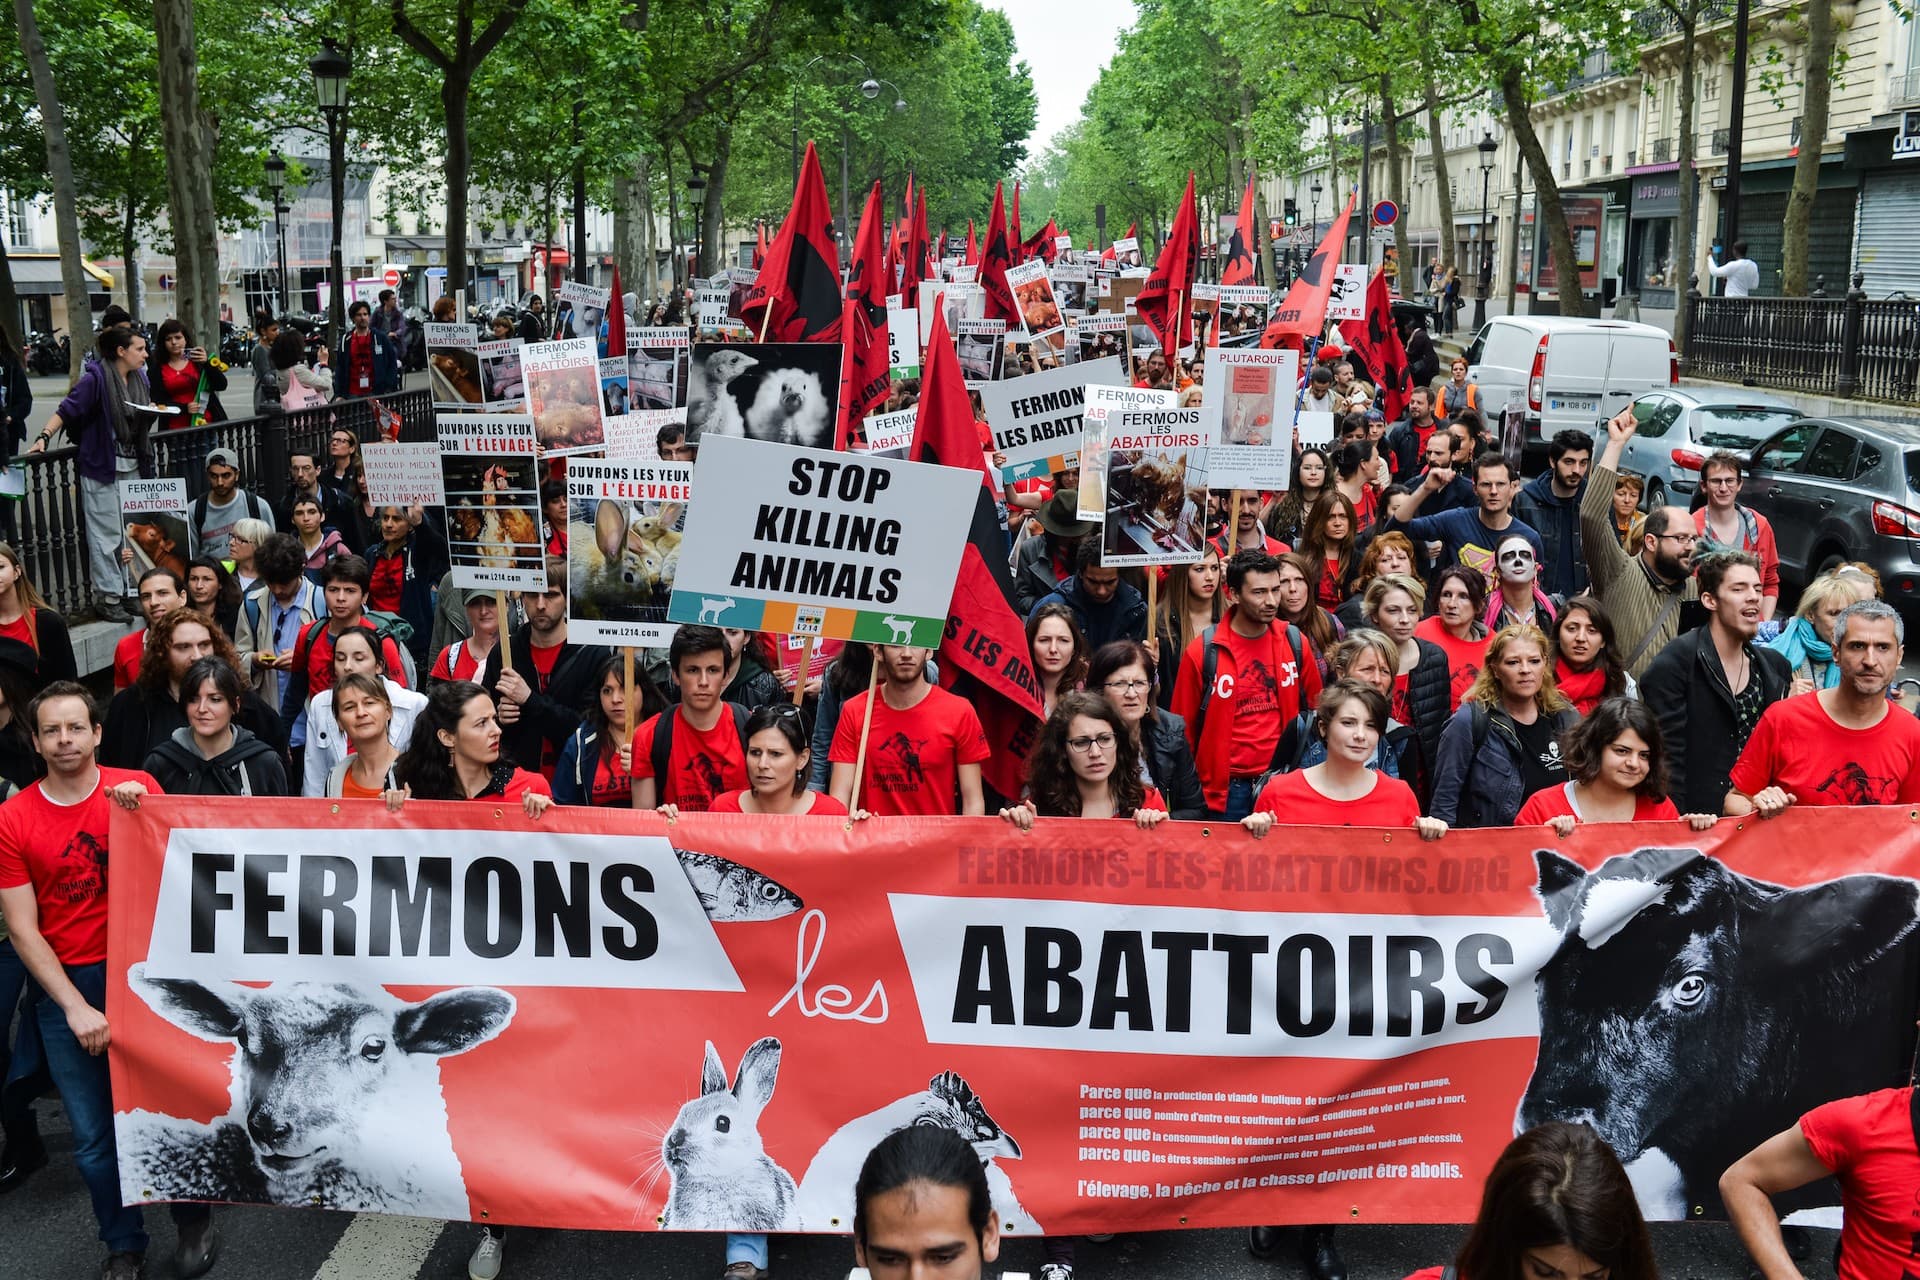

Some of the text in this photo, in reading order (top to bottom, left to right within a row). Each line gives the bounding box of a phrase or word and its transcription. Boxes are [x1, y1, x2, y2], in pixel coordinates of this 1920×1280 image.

[737, 269, 759, 277] FERMO
[1010, 262, 1040, 277] FERMONS
[567, 282, 603, 297] FERMONS
[561, 293, 602, 307] ABATTOIRS
[702, 294, 713, 303] NE
[702, 315, 716, 325] LES
[431, 325, 470, 334] FERMONS
[672, 330, 689, 338] YEUX
[427, 338, 472, 346] ABATTOIRS
[528, 340, 587, 356] FERMONS
[550, 352, 568, 360] LES
[600, 358, 624, 368] RMONS
[1219, 353, 1285, 365] PLUTARQUE
[523, 357, 590, 373] ABATTOIRS
[1011, 384, 1086, 419] FERMON
[1097, 389, 1165, 405] FERMONS
[1121, 401, 1140, 410] LES
[875, 412, 917, 430] FERMO
[1122, 411, 1199, 426] FERMONS
[438, 423, 533, 436] OUVRONS LES YEUX
[996, 414, 1084, 450] LES ABATT
[1150, 425, 1171, 435] LES
[439, 435, 534, 453] SUR L'ÉLEVAGE
[871, 432, 912, 450] ABATT
[1110, 434, 1199, 449] ABATTOIRS
[365, 460, 437, 470] BEAUCOUP MIEUX
[367, 472, 404, 481] SACHANT
[569, 465, 690, 483] OUVRONS LES YEUX
[788, 457, 891, 504] STOP
[128, 482, 177, 494] FERMONS
[393, 483, 409, 492] PAS
[411, 483, 437, 492] MORT
[569, 481, 691, 500] SUR L'ÉLEVAGE
[123, 498, 179, 511] ABATTOIRS
[371, 492, 439, 503] EN HURLANT
[753, 504, 902, 556] KILLING
[730, 551, 902, 604] ANIMALS
[598, 627, 660, 638] www.L214.com
[963, 628, 1002, 667] LES
[957, 846, 1512, 894] FERMONS-LES-ABATTOIRS.ORG
[190, 852, 659, 962] FERMONS
[767, 909, 890, 1024] les
[951, 924, 1515, 1038] ABATTOIRS
[1080, 1084, 1122, 1100] Parce
[1124, 1087, 1152, 1101] que
[1153, 1091, 1162, 1100] la
[1163, 1091, 1213, 1102] production
[1214, 1091, 1226, 1102] de
[1227, 1092, 1258, 1103] viande
[1261, 1093, 1302, 1106] implique
[1305, 1095, 1317, 1106] de
[1350, 1086, 1386, 1098] animaux
[1387, 1083, 1403, 1094] que
[1404, 1081, 1420, 1092] l'on
[1080, 1106, 1122, 1120] parce
[1124, 1107, 1152, 1121] que
[1154, 1111, 1189, 1122] nombre
[1191, 1111, 1223, 1123] d'entre
[1224, 1114, 1240, 1124] eux
[1241, 1115, 1283, 1126] souffrent
[1285, 1115, 1296, 1126] de
[1298, 1114, 1320, 1125] leurs
[1322, 1105, 1368, 1121] conditions
[1368, 1105, 1379, 1116] de
[1381, 1103, 1393, 1114] vie
[1394, 1101, 1403, 1111] et
[1404, 1100, 1415, 1110] de
[1416, 1096, 1436, 1108] mise
[1079, 1126, 1121, 1140] parce
[1124, 1128, 1151, 1142] que
[1152, 1131, 1161, 1141] la
[1163, 1133, 1230, 1145] consommation
[1231, 1135, 1242, 1145] de
[1244, 1134, 1274, 1145] viande
[1275, 1134, 1297, 1145] n'est
[1298, 1132, 1314, 1143] pas
[1315, 1131, 1332, 1140] une
[1079, 1146, 1121, 1161] parce
[1123, 1148, 1151, 1164] que
[1152, 1152, 1166, 1163] les
[1167, 1152, 1191, 1164] êtres
[1192, 1154, 1236, 1166] sensibles
[1398, 1135, 1418, 1146] sans
[1077, 1160, 1464, 1200] l'élevage, la pêche et la chasse doivent être abolis.
